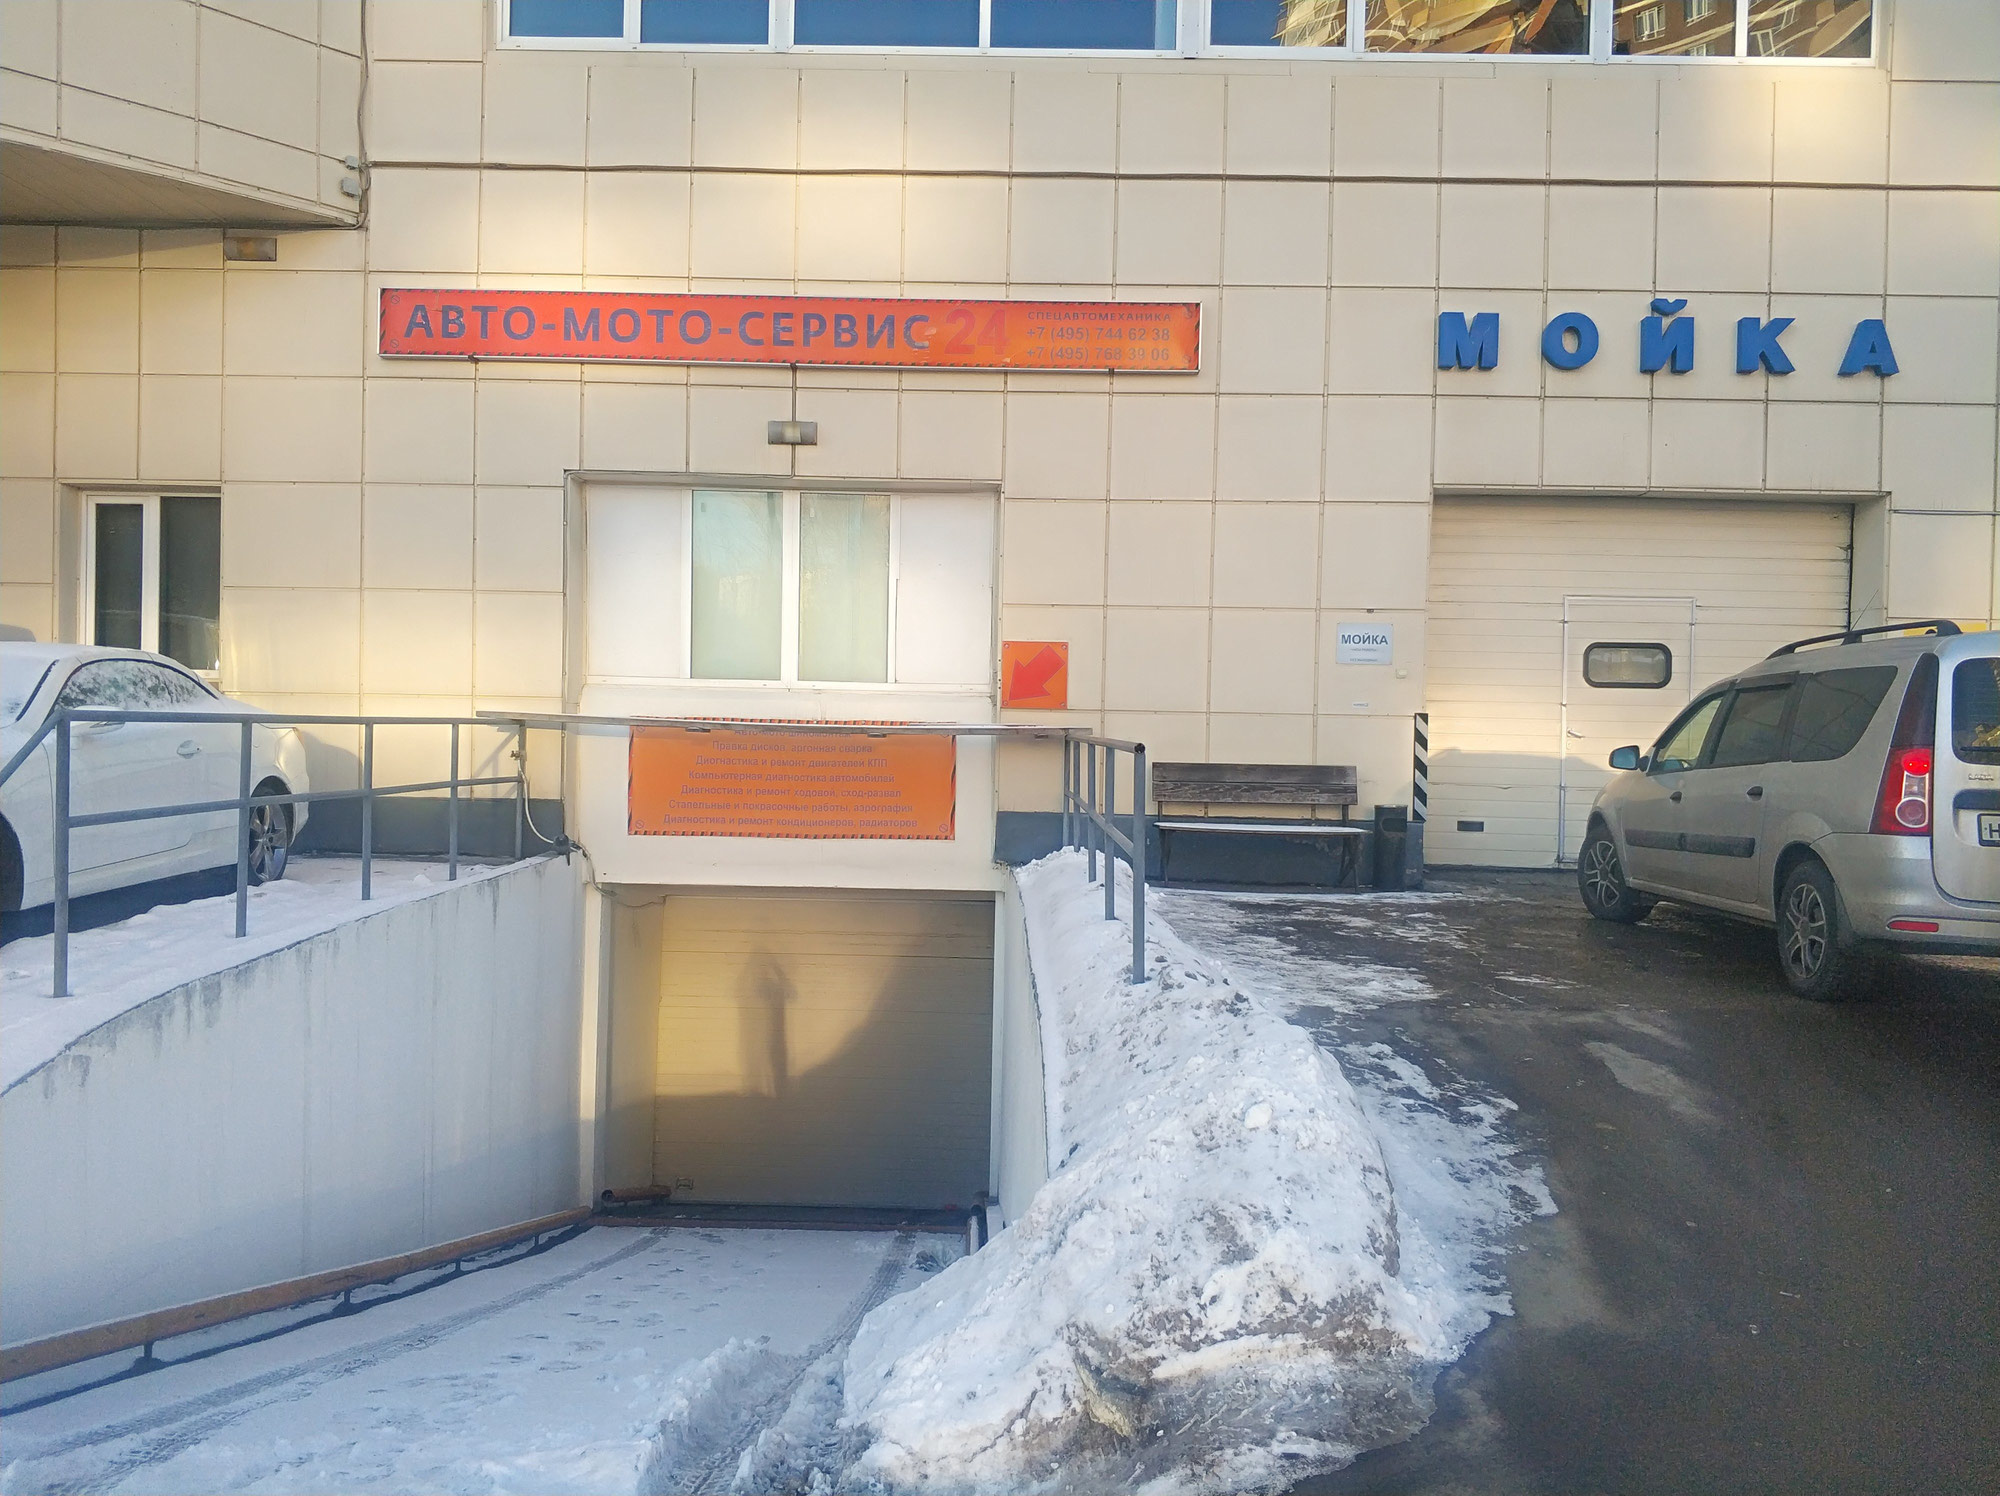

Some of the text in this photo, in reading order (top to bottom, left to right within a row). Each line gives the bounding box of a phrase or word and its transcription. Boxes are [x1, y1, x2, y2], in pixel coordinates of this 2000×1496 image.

[1027, 311, 1171, 321] СПЕЦАВТОМЕХАНИКА
[404, 304, 1010, 355] АВТО-МОТО-СЕРВИС 24
[1027, 327, 1170, 342] +7 (495) 744 62 38
[1438, 298, 1900, 377] МОЙКА
[1027, 347, 1169, 362] +7 (495) 768 39 06
[1341, 632, 1388, 645] МОЙКА
[712, 740, 748, 751] Правка
[791, 744, 836, 753] аргонная
[839, 745, 872, 754] сварка
[761, 758, 767, 766] и
[770, 758, 806, 768] ремонт
[808, 758, 865, 769] двигателей
[867, 758, 888, 768] КПП
[689, 770, 894, 783] Компьютерная диагностика автомобилей
[680, 785, 744, 796] Диагностика
[747, 788, 752, 796] и
[755, 788, 790, 798] ремонт
[840, 789, 901, 799] сход-развал
[668, 799, 731, 810] Стапельные
[733, 802, 740, 810] и
[742, 802, 809, 812] покрасочные
[663, 813, 726, 825] Диагностика
[729, 816, 735, 825] и
[737, 817, 774, 827] ремонт
[859, 819, 918, 829] радиаторов
